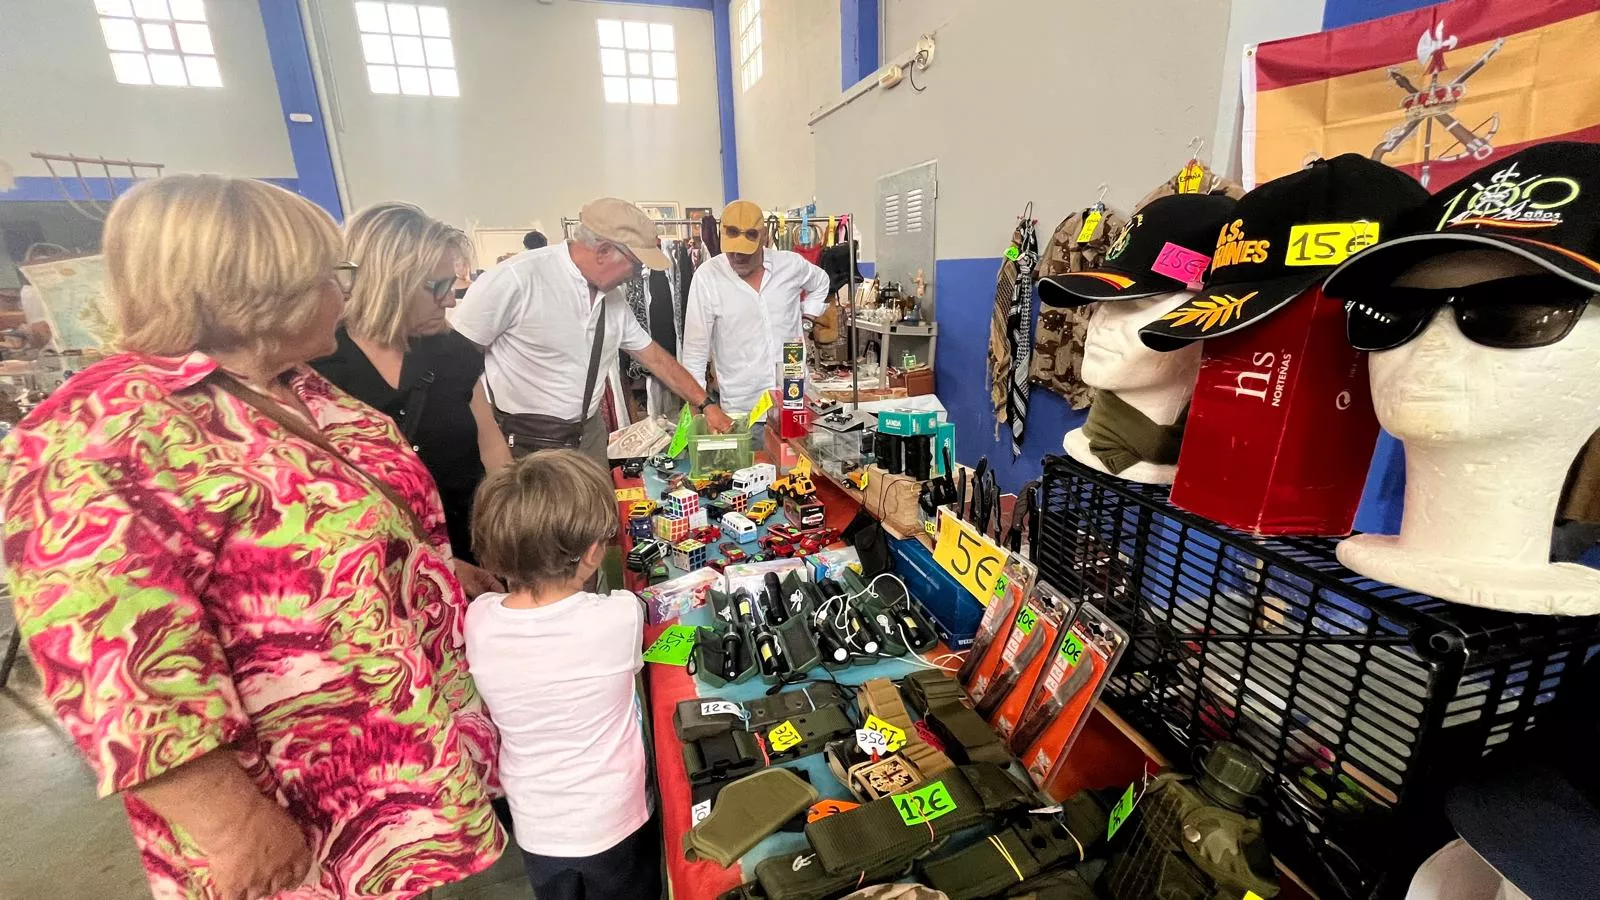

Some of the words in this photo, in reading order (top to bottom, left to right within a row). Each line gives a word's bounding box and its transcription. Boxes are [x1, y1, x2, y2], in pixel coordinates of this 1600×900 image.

[1523, 209, 1561, 219] años
[1293, 231, 1373, 261] 15€
[1160, 247, 1205, 275] 15€
[1235, 351, 1276, 403] ns
[1271, 353, 1292, 407] NORTEÑAS
[950, 529, 1000, 592] 5€
[1017, 609, 1035, 630] 10€
[1061, 638, 1081, 662] 10€
[703, 703, 733, 714] 12€
[774, 726, 799, 746] 12€
[859, 732, 885, 746] 25€
[899, 788, 949, 820] 12€
